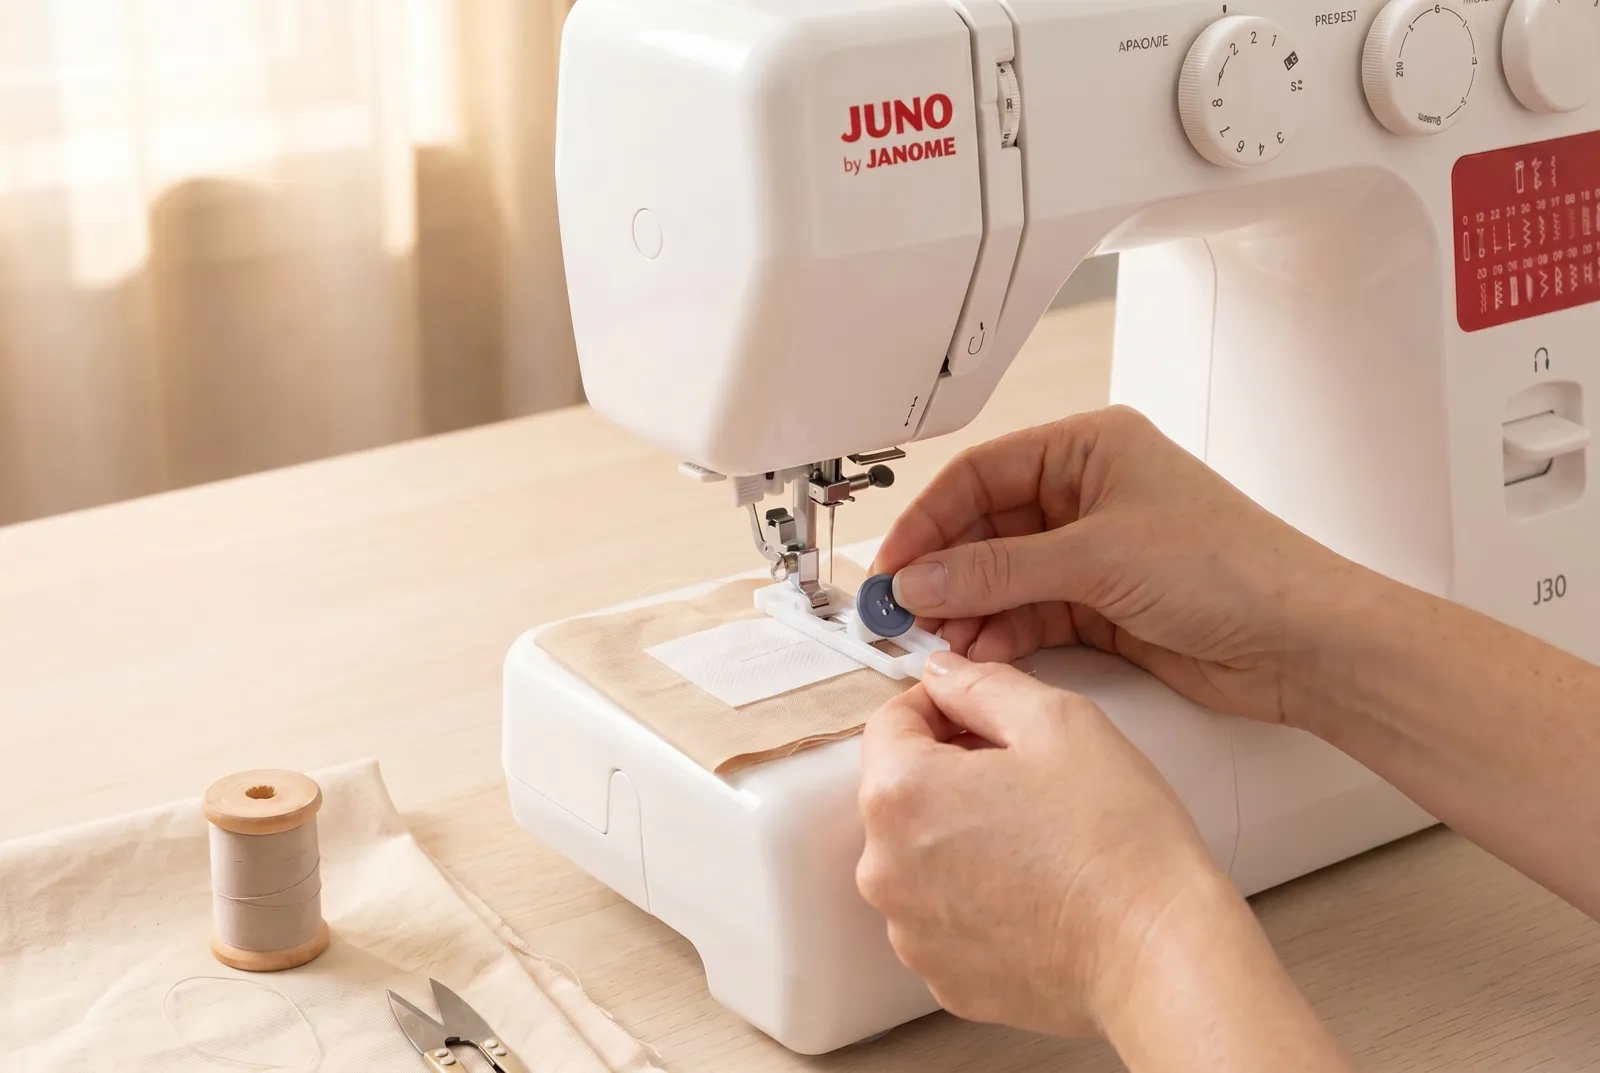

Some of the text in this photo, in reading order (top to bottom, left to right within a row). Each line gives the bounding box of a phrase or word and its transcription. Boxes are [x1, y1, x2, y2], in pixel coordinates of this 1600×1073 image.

[1434, 4, 1441, 14] 6
[1250, 31, 1258, 44] 2
[1229, 43, 1239, 55] 2
[1212, 98, 1223, 107] 8
[841, 93, 954, 144] JUNO
[843, 136, 957, 176] by JANOME
[1533, 573, 1568, 606] J30
